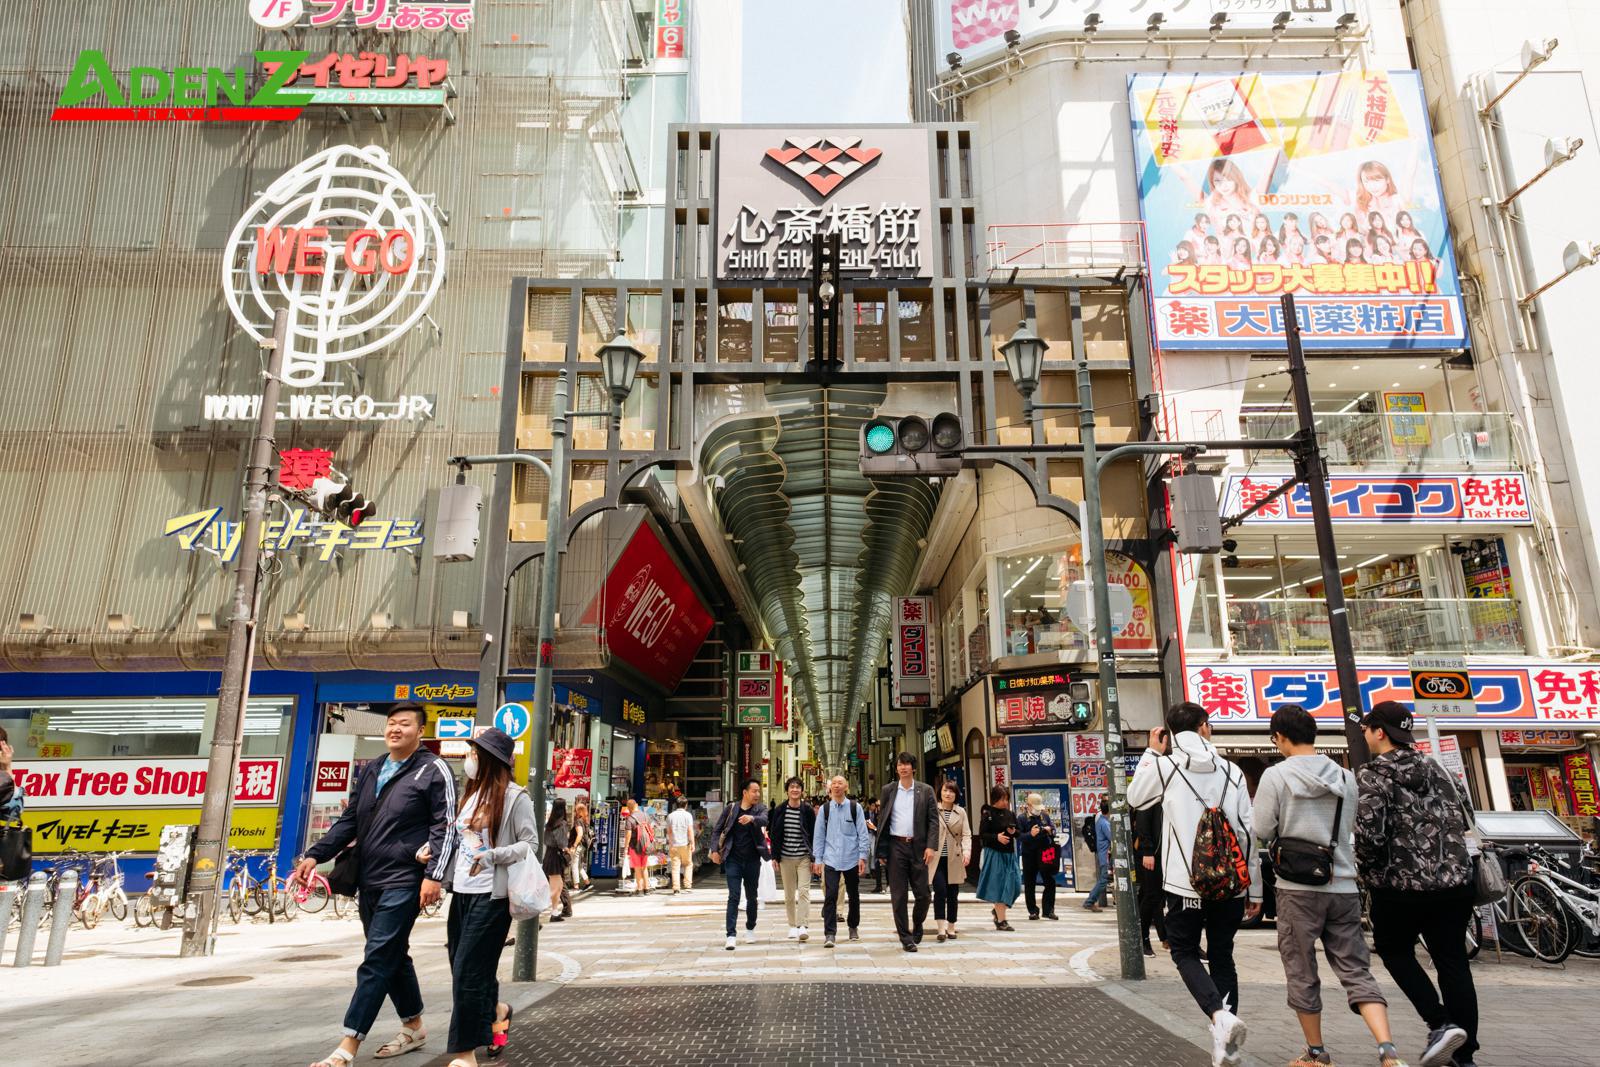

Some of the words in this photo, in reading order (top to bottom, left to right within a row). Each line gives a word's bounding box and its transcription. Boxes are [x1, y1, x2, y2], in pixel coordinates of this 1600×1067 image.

[728, 202, 921, 245] 心斎橋筋
[1167, 262, 1436, 295] スタッフ大募集中!!
[1167, 300, 1213, 336] 薬
[279, 447, 334, 491] 薬
[1239, 476, 1283, 519] 薬
[1462, 477, 1526, 508] 免税
[1467, 508, 1529, 520] Tax-Free
[1470, 585, 1493, 599] 2F
[623, 578, 676, 649] WEGO
[903, 598, 922, 621] 薬
[905, 626, 922, 674] ダイコク
[1006, 696, 1046, 721] 日焼
[1200, 672, 1248, 718] 薬
[1262, 674, 1524, 714] ダイク
[1431, 704, 1461, 713] 大阪市
[1019, 753, 1039, 762] BOSS
[1075, 734, 1100, 757] 薬
[11, 768, 59, 797] Tax
[64, 767, 126, 796] Free
[134, 766, 208, 797] Shop
[36, 819, 150, 845] マツモトキヨシ
